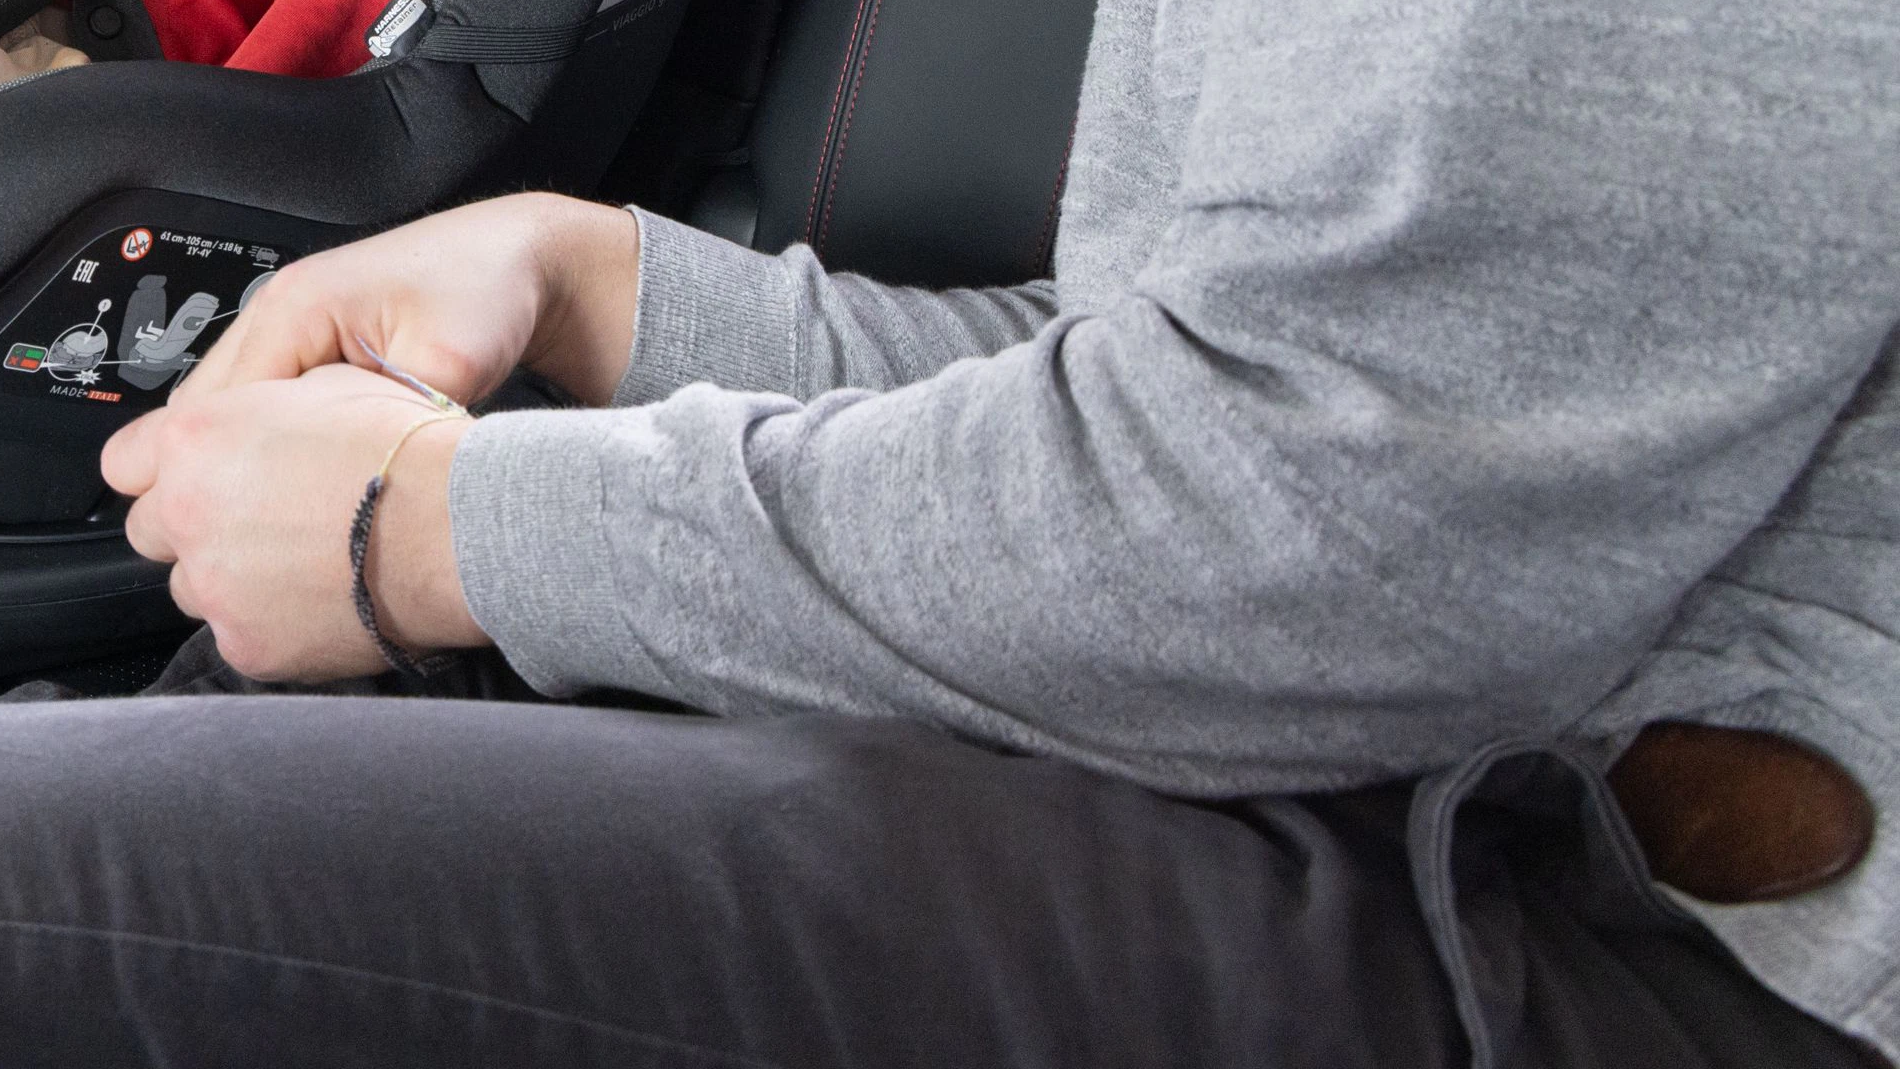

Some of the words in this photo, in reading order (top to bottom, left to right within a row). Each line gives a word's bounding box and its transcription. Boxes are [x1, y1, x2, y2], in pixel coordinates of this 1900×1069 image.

[385, 3, 417, 35] Retainer
[160, 231, 171, 241] 61
[186, 246, 212, 258] 1Y-4Y
[72, 259, 100, 283] EAC
[49, 385, 84, 398] MADE
[89, 390, 121, 402] ITALY
